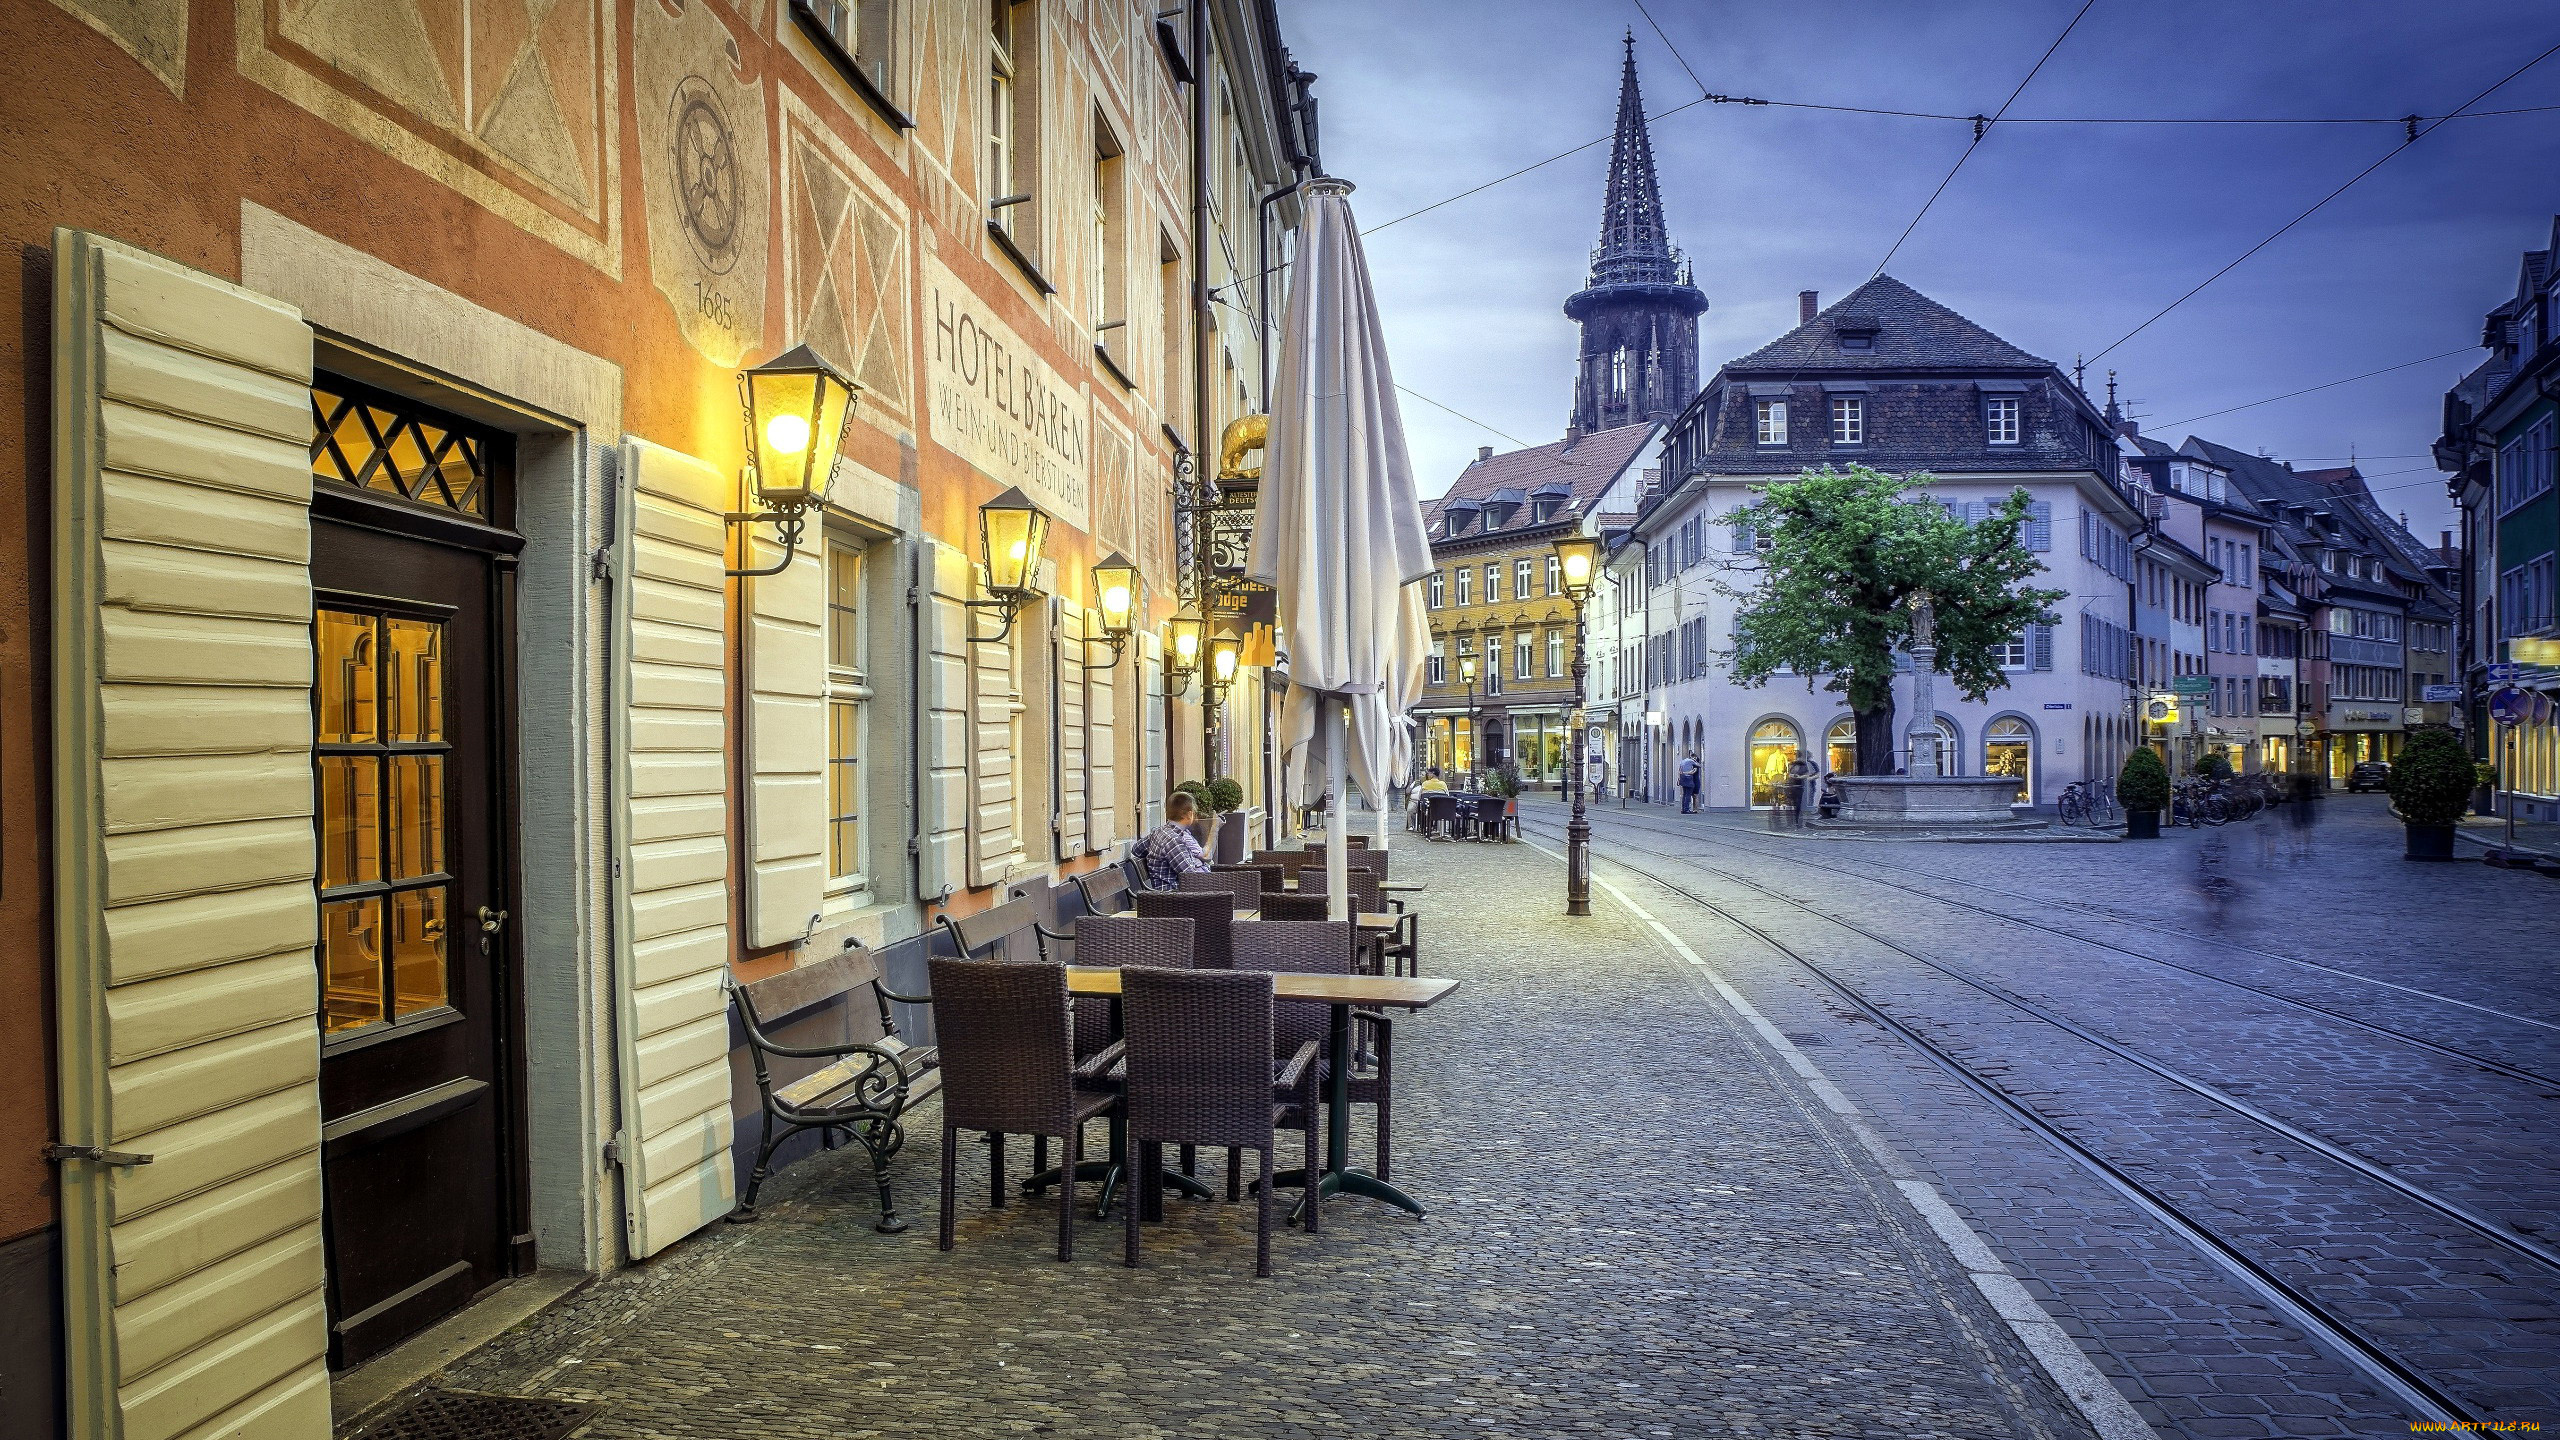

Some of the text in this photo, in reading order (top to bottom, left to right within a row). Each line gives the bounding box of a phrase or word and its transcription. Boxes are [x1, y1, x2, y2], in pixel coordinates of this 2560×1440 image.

[693, 280, 732, 330] 1685
[934, 287, 1084, 472] HOTEL BÄREN
